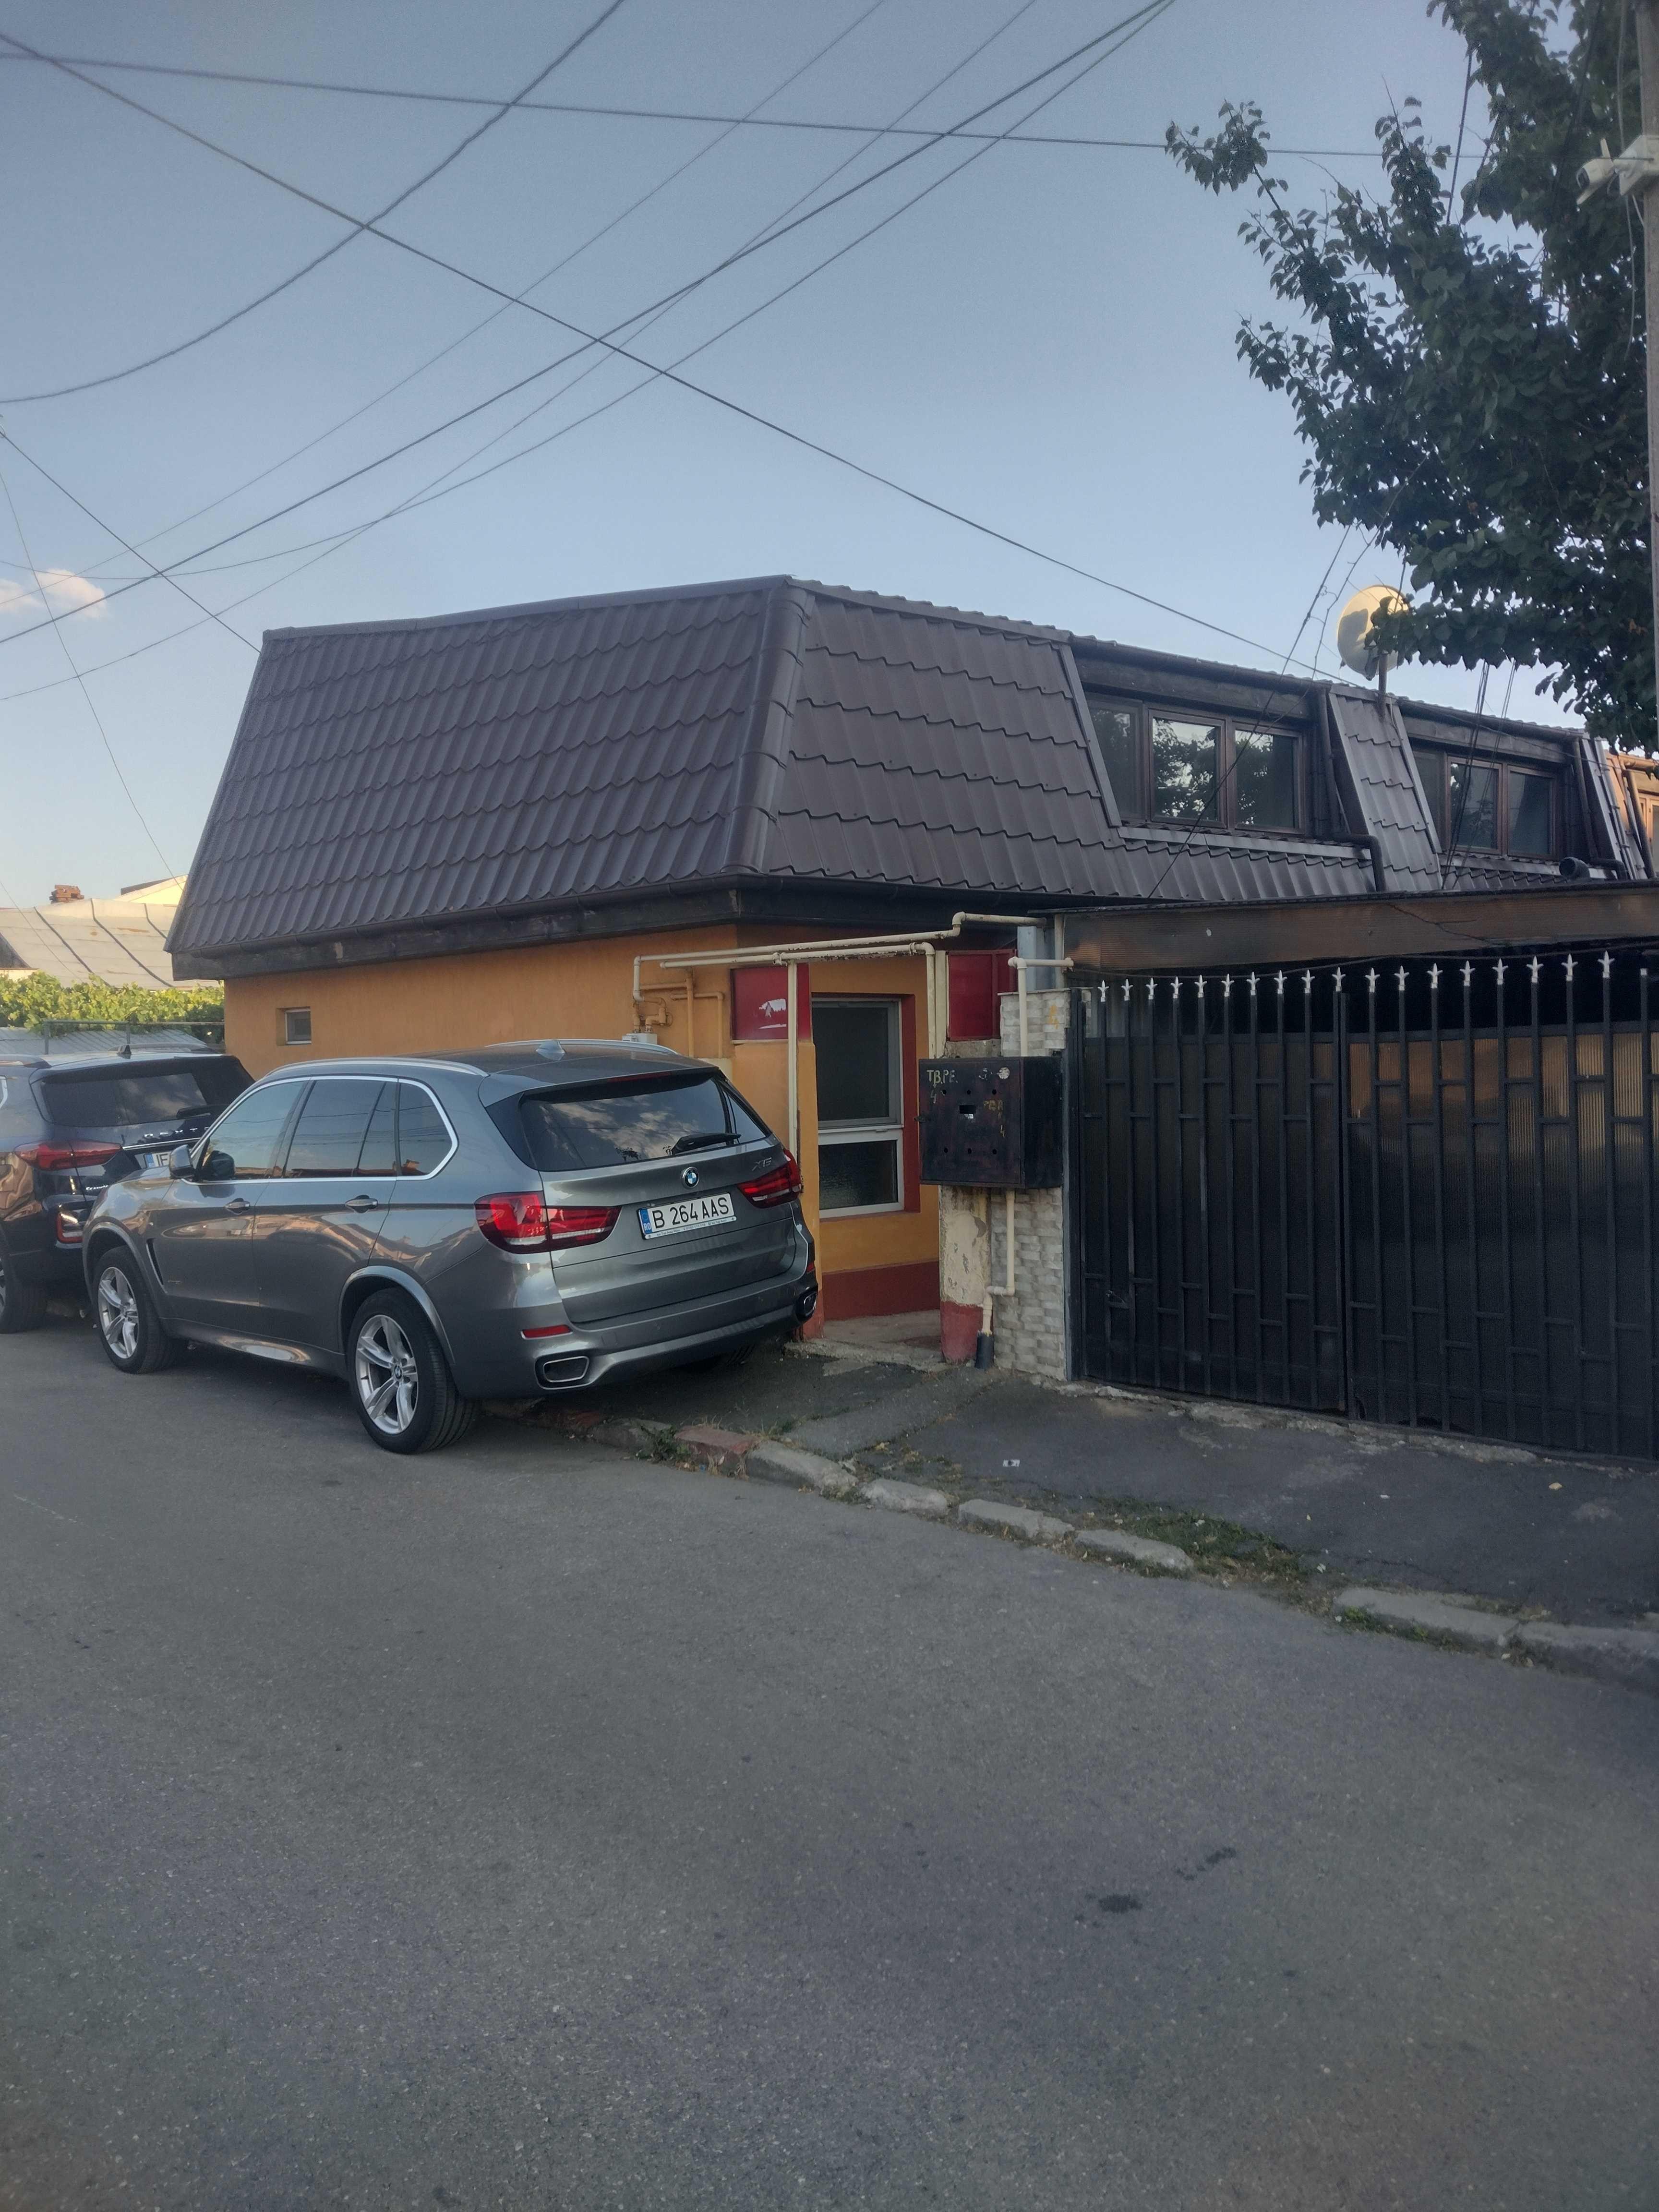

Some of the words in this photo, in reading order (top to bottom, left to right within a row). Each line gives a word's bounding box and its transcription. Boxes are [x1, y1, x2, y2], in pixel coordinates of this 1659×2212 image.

[652, 1210, 665, 1228] B
[670, 1203, 698, 1225] 264
[702, 1197, 729, 1219] AAS
[643, 1223, 651, 1231] RO
